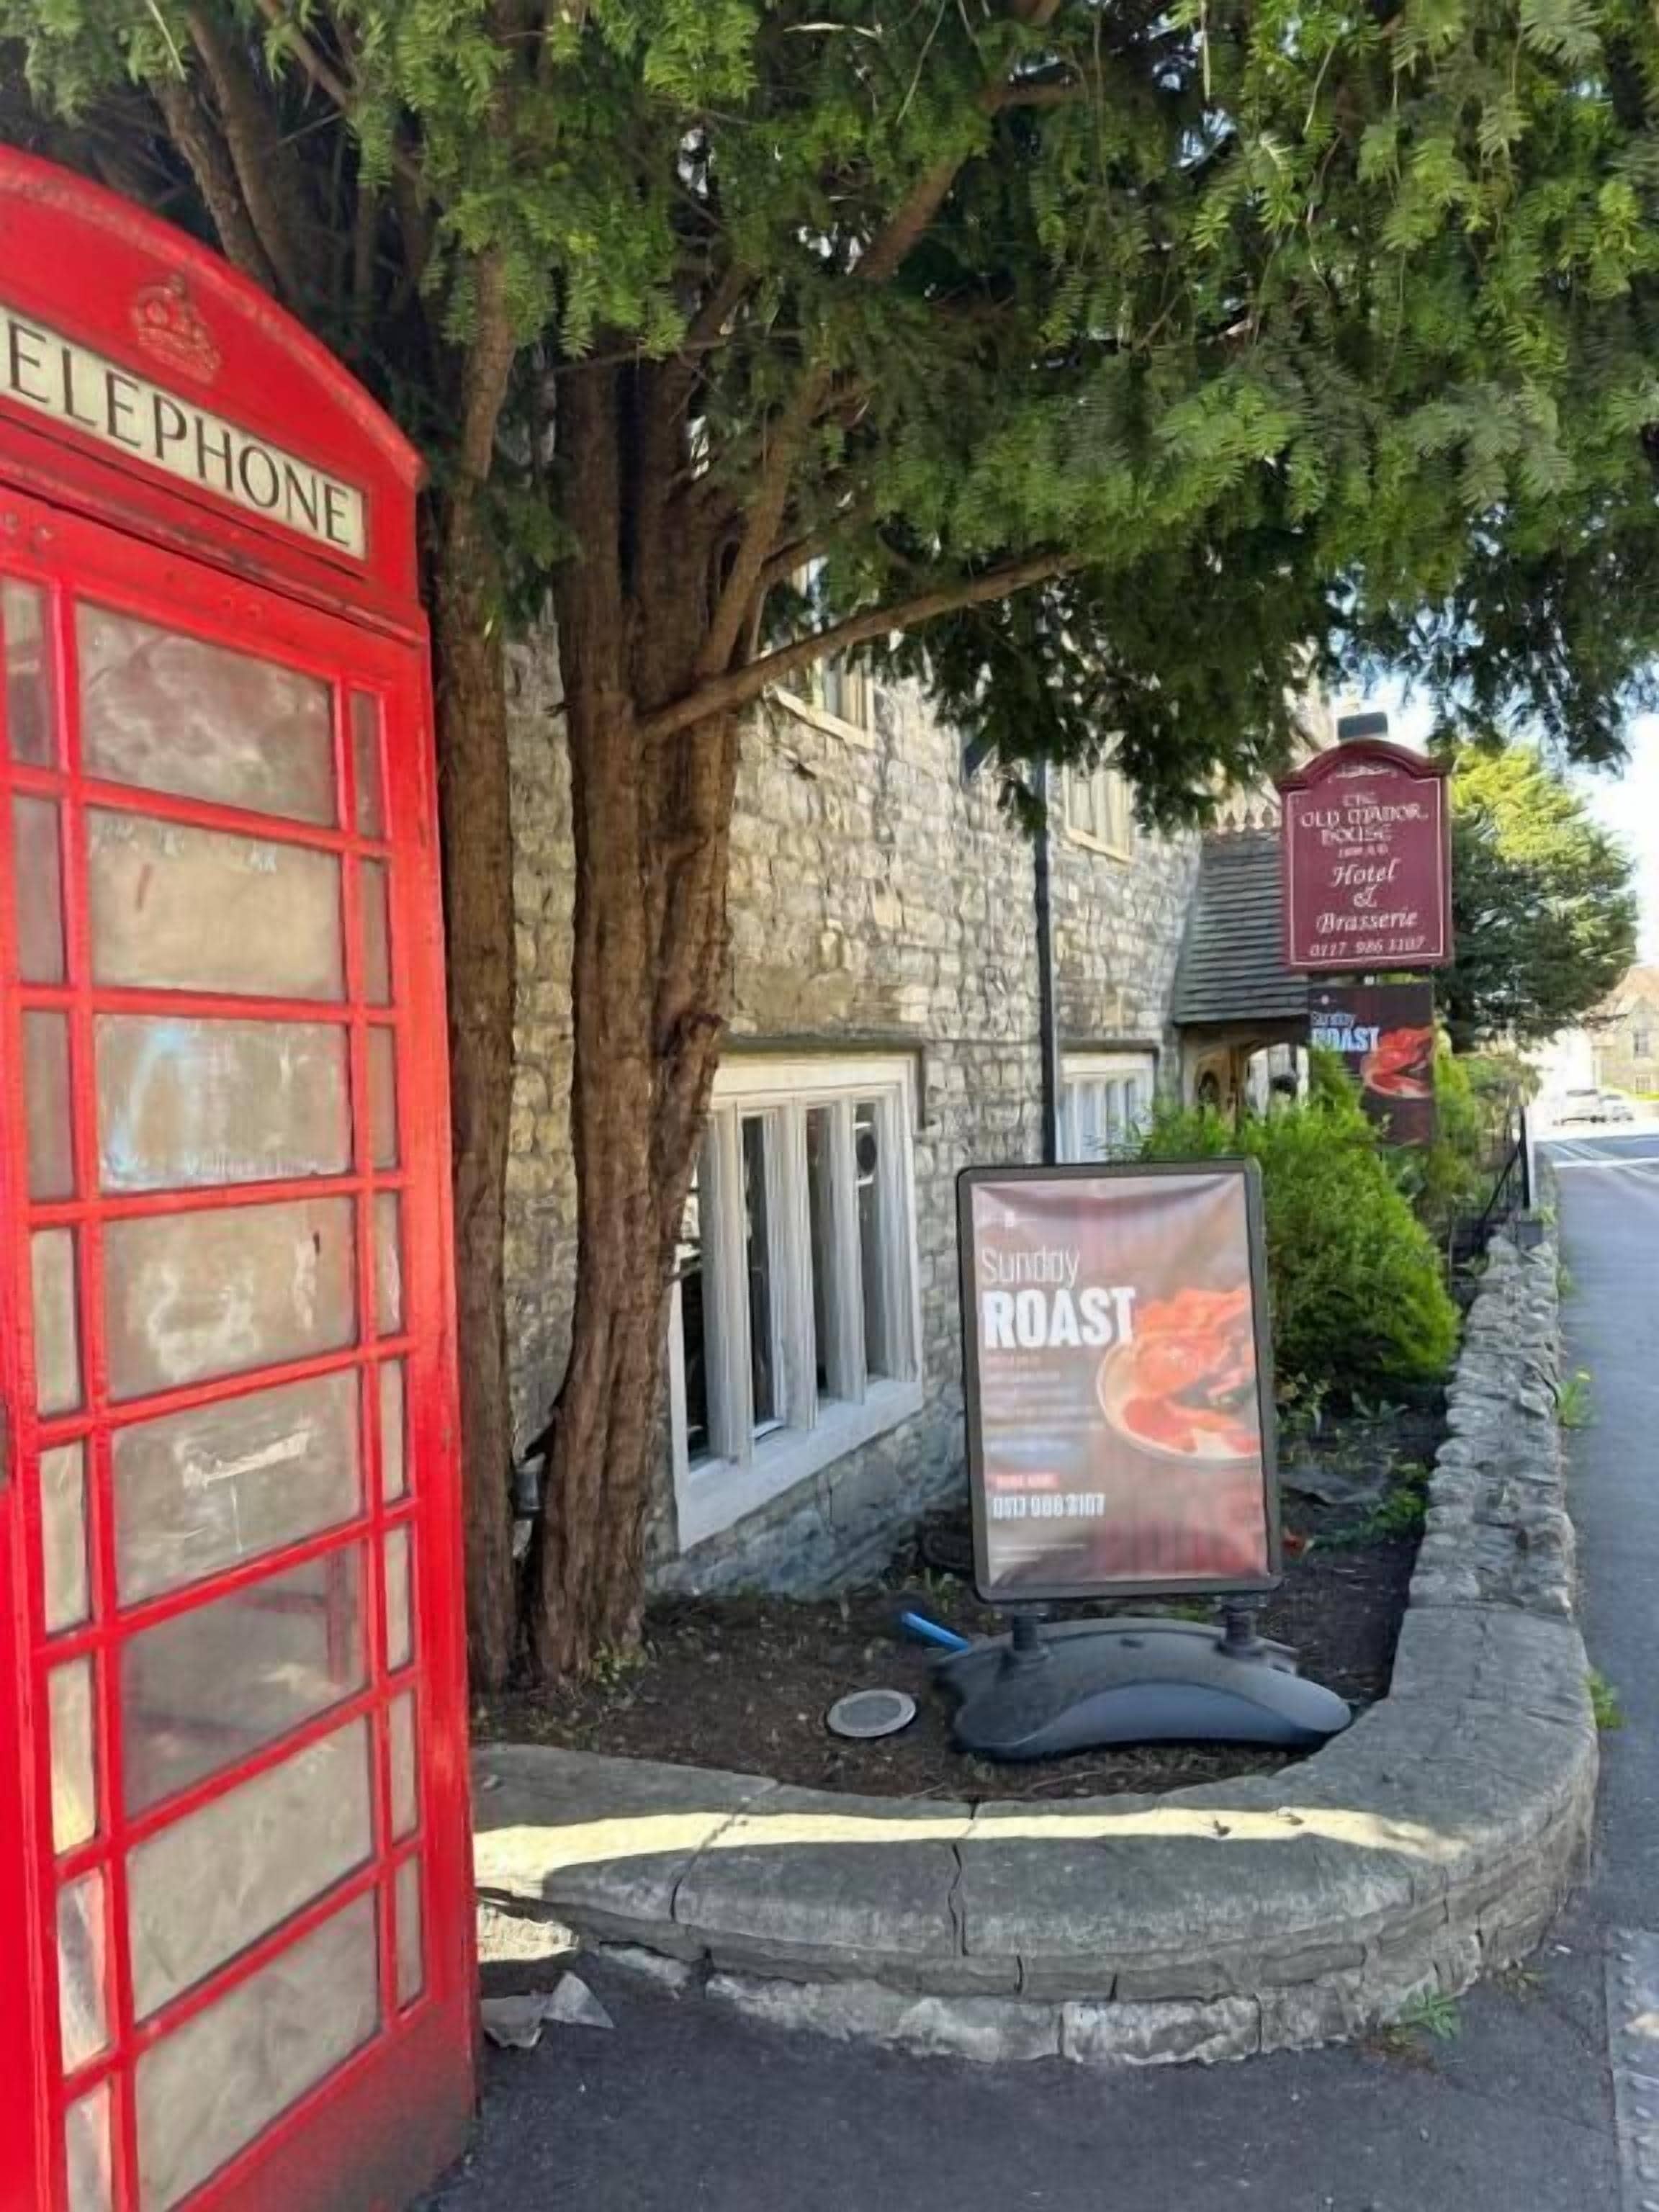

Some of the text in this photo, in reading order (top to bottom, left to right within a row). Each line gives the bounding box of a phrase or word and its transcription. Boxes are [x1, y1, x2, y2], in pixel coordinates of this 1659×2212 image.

[1331, 858, 1401, 887] Hotel
[1316, 906, 1417, 933] Brasserie
[981, 1245, 1080, 1288] Sunday
[982, 1286, 1136, 1349] ROAST
